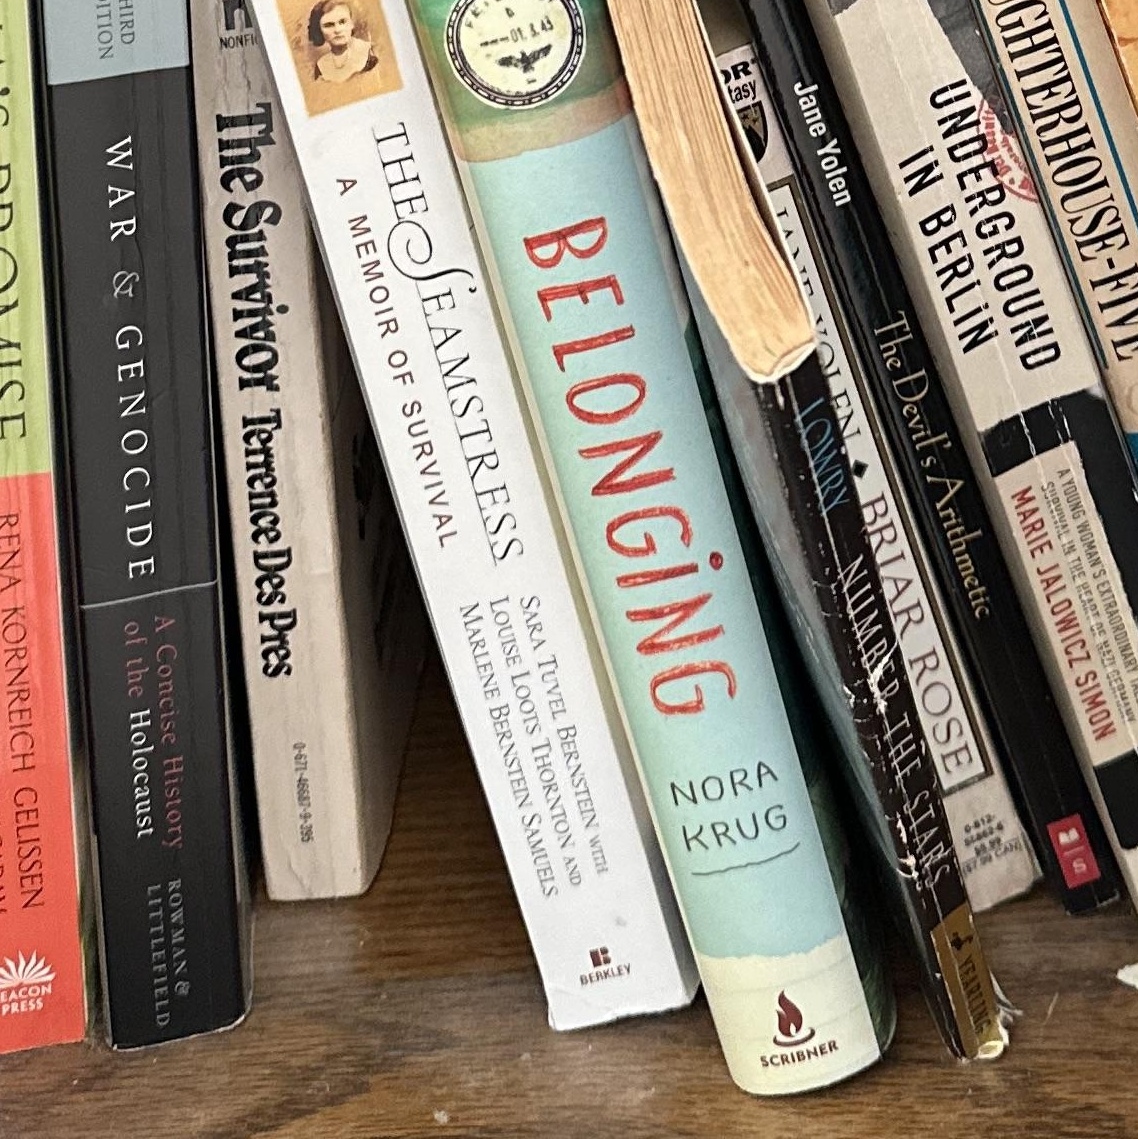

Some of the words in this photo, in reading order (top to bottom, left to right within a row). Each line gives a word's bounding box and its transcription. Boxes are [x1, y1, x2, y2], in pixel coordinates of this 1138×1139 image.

[105, 134, 137, 241] WAR
[215, 102, 273, 193] The
[336, 177, 358, 196] A
[372, 122, 431, 222] THE
[794, 81, 827, 139] Jane
[816, 137, 852, 207] Yolen
[898, 146, 940, 197] IN
[929, 78, 1062, 371] UNDERGROUND
[111, 270, 140, 299] &
[222, 195, 290, 394] Survivor
[348, 214, 398, 340] MEMOIR
[917, 203, 1000, 356] BERLIN
[386, 217, 526, 568] SEAMSTRESS
[391, 351, 414, 386] OF
[114, 324, 156, 581] GENOCIDE
[240, 409, 287, 554] Terrence
[402, 401, 458, 549] SURVIVAL
[798, 397, 850, 514] LOWRY
[873, 309, 906, 372] The
[892, 369, 952, 468] Devil's
[926, 469, 991, 620] Arithmetic
[1057, 467, 1071, 480] A
[1061, 477, 1087, 520] YOUNG
[255, 547, 293, 608] Des
[1068, 554, 1088, 583] THE
[1075, 517, 1108, 581] WOMAN'S
[123, 620, 148, 648] of
[154, 615, 176, 629] A
[257, 607, 298, 679] Pres
[862, 490, 925, 641] BRIAR
[908, 646, 974, 775] ROSE
[1010, 484, 1055, 560] MARIE
[1036, 562, 1093, 670] JALOWICZ
[1074, 668, 1118, 742] SIMON
[1, 605, 36, 772] KORNREICH
[125, 659, 145, 699] the
[154, 642, 178, 746] Concise
[129, 707, 155, 838] Holocaust
[460, 601, 501, 701] MARLENE
[489, 703, 534, 809] BERNSTEIN
[521, 812, 560, 899] SAMUELS
[490, 594, 522, 667] LOUISE
[510, 670, 541, 736] LOOTS
[532, 737, 576, 850] THORNTON
[563, 856, 582, 888] AND
[520, 595, 548, 651] SARA
[537, 654, 568, 720] TUVEL
[557, 723, 599, 830] BERNSTEIN
[589, 834, 609, 874] WITH
[883, 711, 923, 790] THE
[162, 756, 185, 850] History
[669, 760, 780, 807] NORA
[680, 806, 790, 852] KRUG
[13, 786, 45, 910] GELISSEN
[146, 884, 171, 1027] LITTLEFIELD
[168, 877, 189, 974] ROWMAN
[0, 982, 53, 1005] EACON
[2, 996, 44, 1017] PRESS
[174, 978, 190, 998] &
[579, 963, 632, 986] BERKLEY
[957, 958, 991, 1036] YEARLING
[759, 1038, 840, 1068] SCRIBNER
